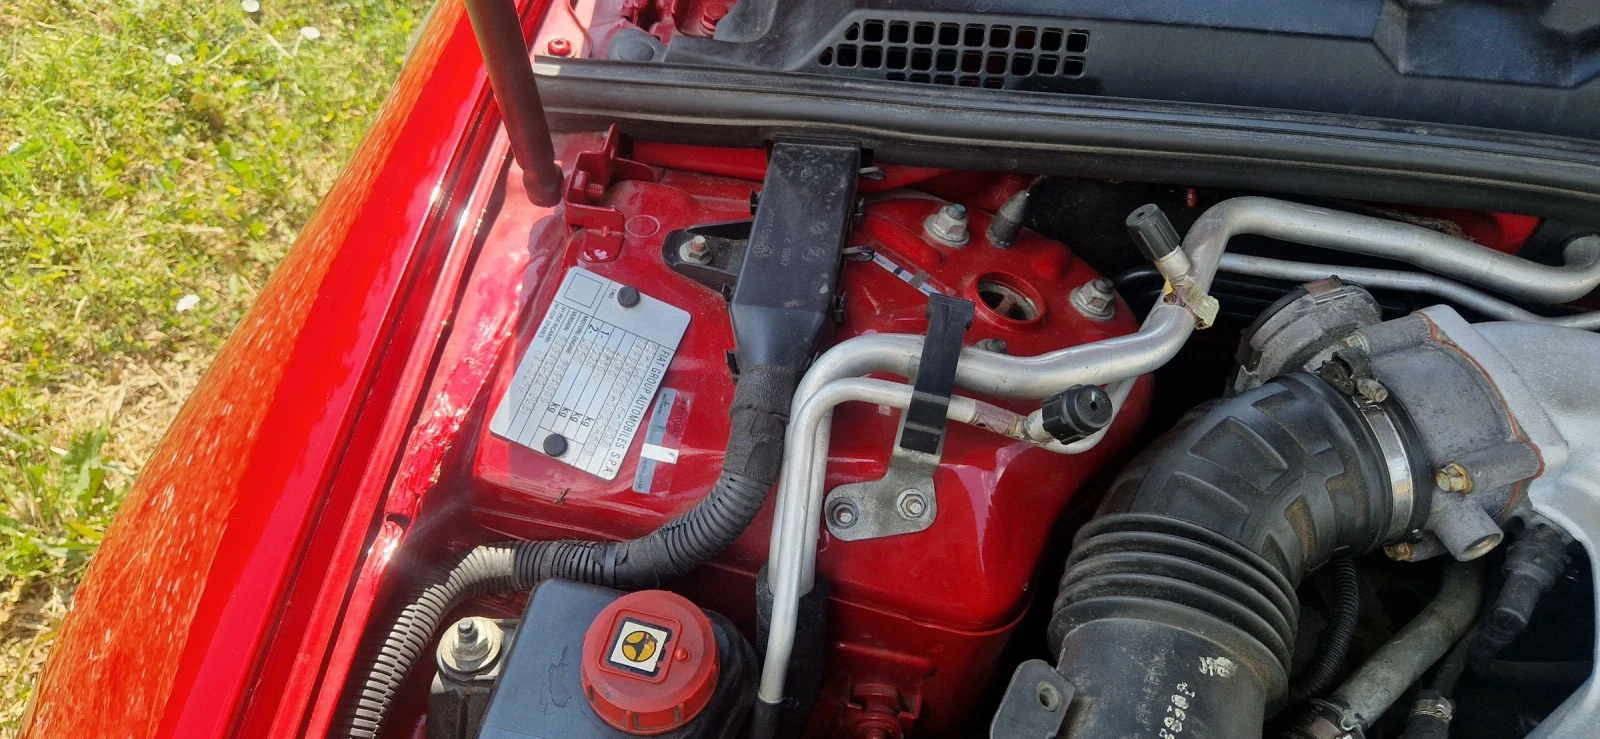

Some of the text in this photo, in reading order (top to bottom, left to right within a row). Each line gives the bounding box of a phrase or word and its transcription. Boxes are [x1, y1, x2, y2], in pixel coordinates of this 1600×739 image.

[547, 309, 555, 320] FOR
[554, 312, 562, 322] PER
[562, 310, 576, 331] VERSION
[537, 319, 550, 338] SPARES
[543, 322, 557, 344] RICAMBI
[654, 349, 668, 367] FIAT
[641, 366, 660, 394] GROUP
[546, 401, 559, 414] kg
[558, 406, 571, 419] kg
[569, 410, 582, 423] kg
[581, 415, 593, 428] kg
[614, 393, 647, 449] AUTOMOBILES
